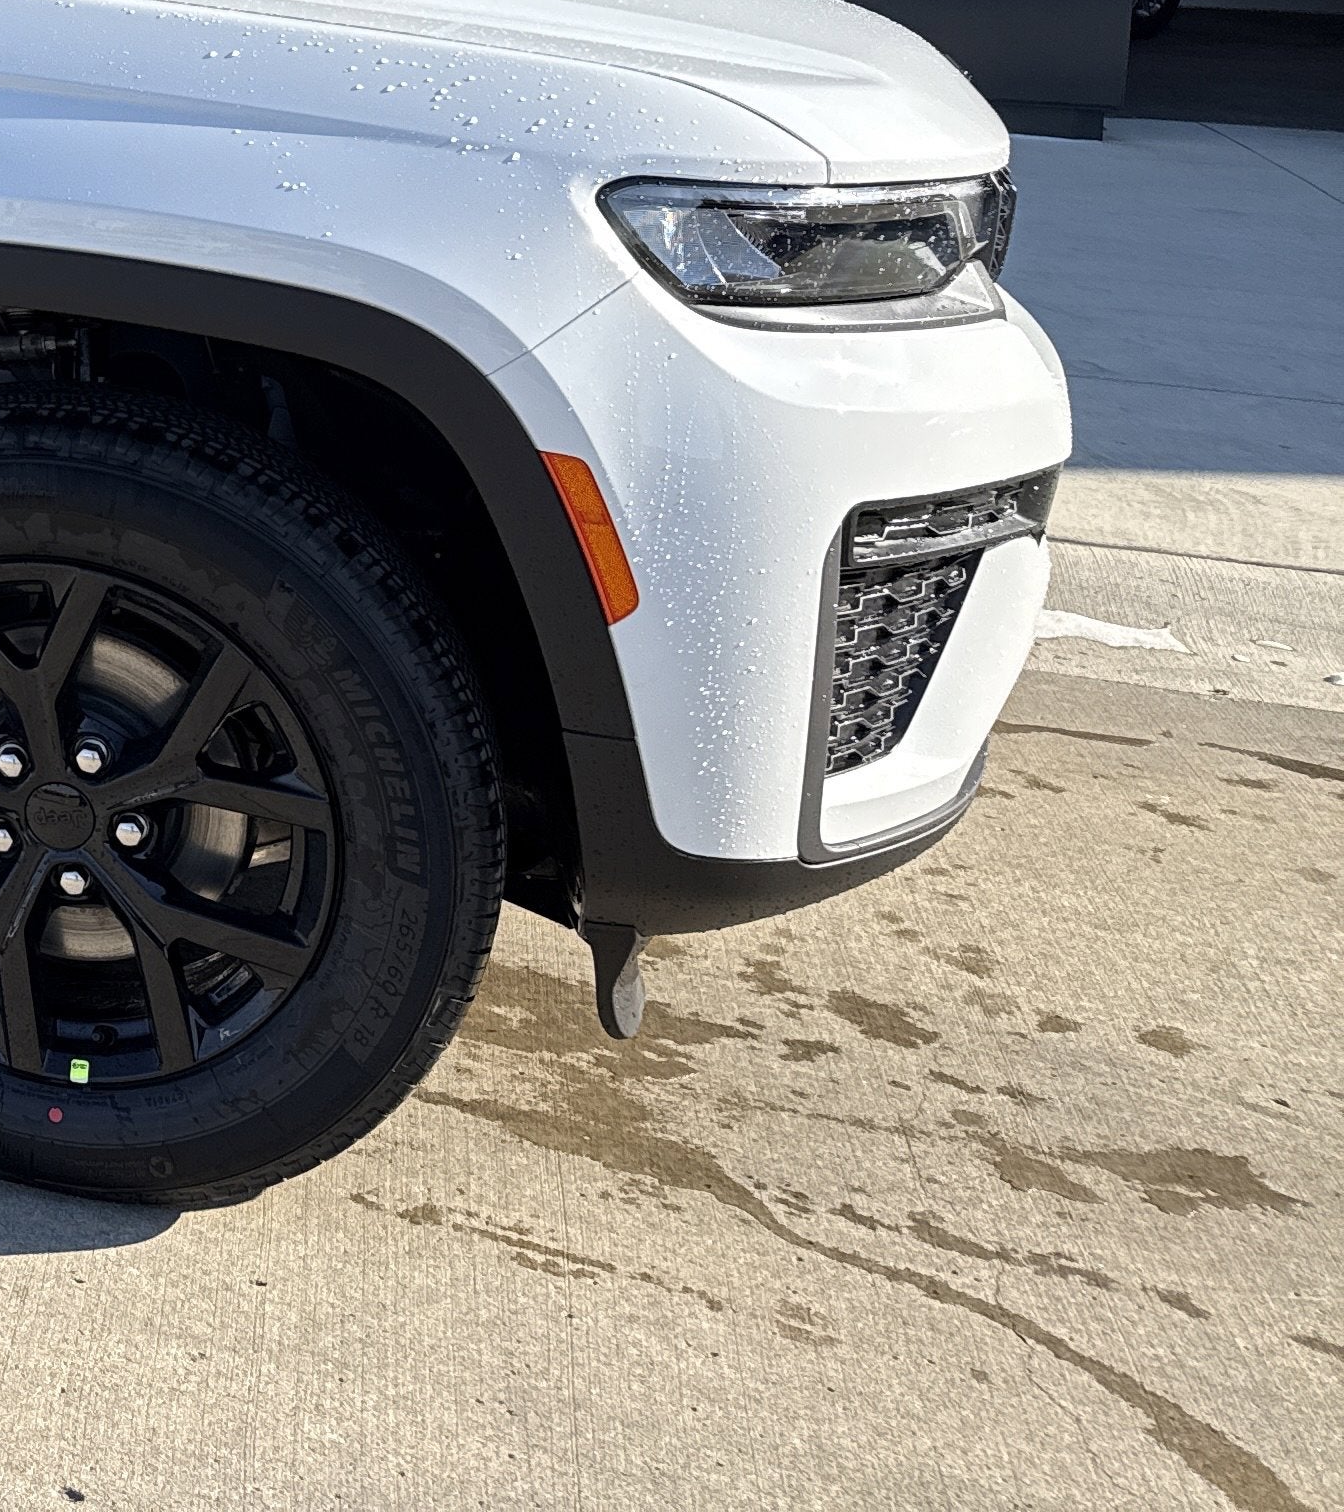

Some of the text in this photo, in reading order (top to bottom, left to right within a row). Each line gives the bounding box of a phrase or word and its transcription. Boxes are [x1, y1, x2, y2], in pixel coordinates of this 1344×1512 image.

[33, 806, 88, 830] Jeep
[334, 669, 422, 874] MICHELIN
[353, 908, 418, 1048] 265/60 R 18
